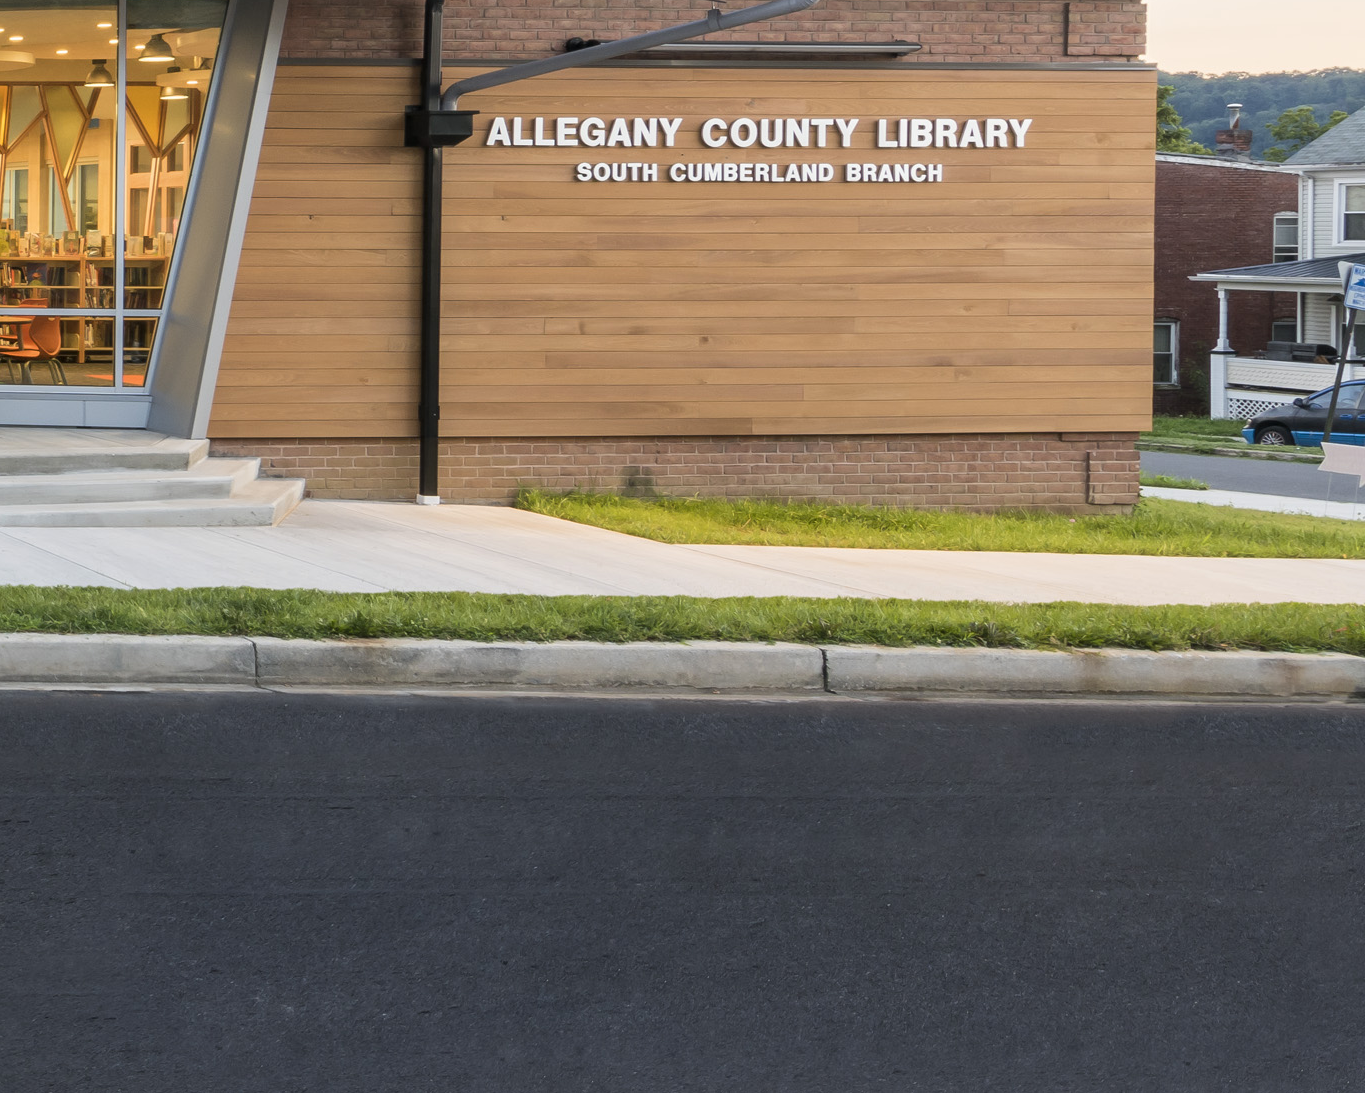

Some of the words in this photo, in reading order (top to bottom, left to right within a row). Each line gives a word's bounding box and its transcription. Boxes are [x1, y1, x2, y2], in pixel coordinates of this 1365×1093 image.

[486, 116, 684, 147] ALLEGANY
[701, 117, 860, 148] COUNTY
[877, 118, 1034, 148] LIBRARY
[576, 162, 658, 182] SOUTH
[670, 162, 835, 182] CUMBERLAND
[846, 163, 943, 183] BRANCH
